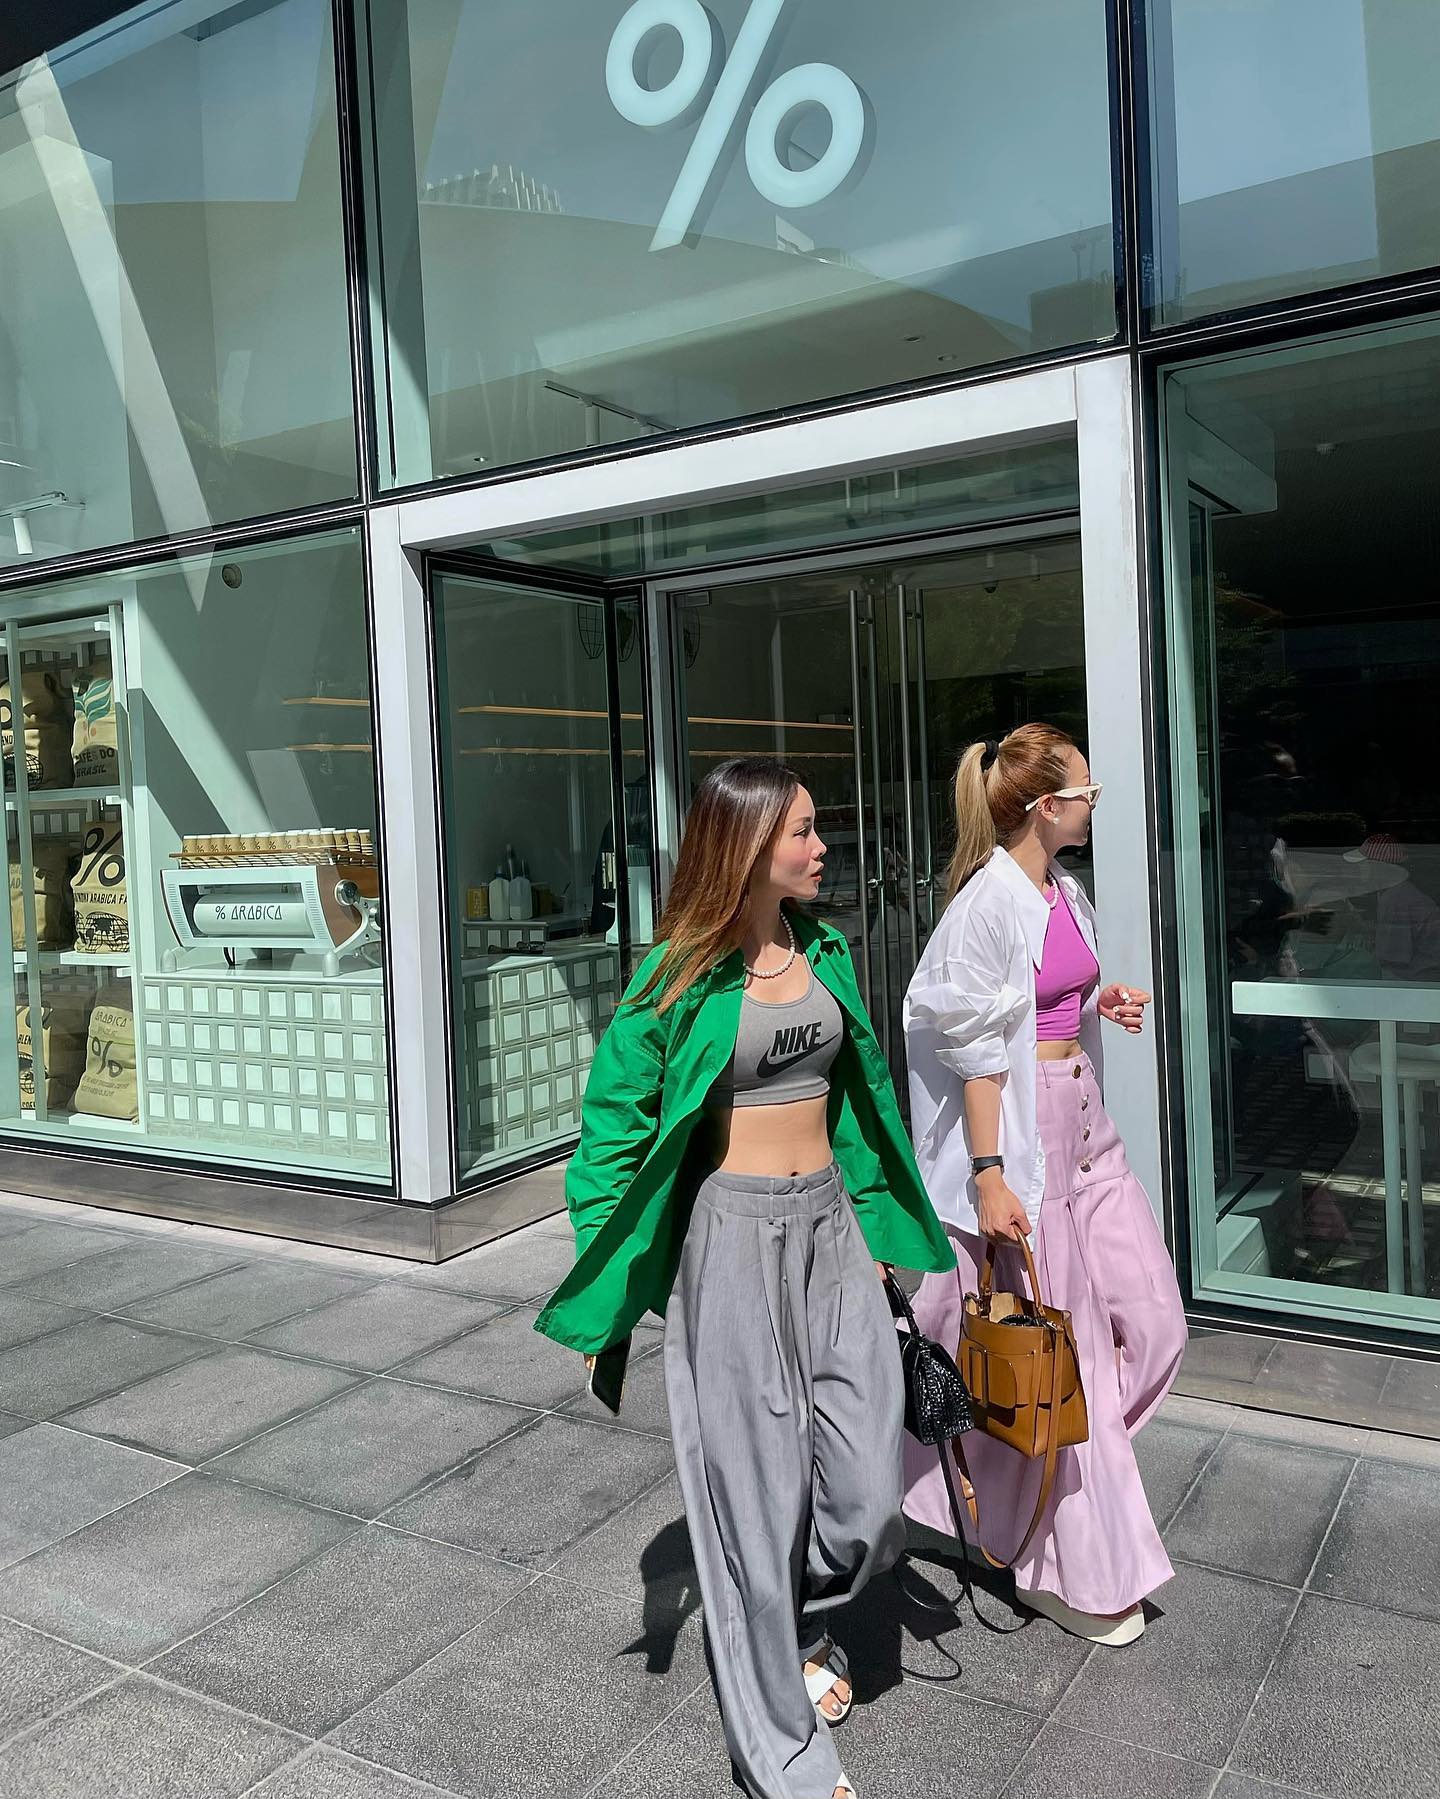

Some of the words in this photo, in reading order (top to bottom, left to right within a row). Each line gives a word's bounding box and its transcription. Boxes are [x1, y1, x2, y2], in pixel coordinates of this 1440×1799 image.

[605, 0, 866, 252] %
[99, 748, 115, 759] DO
[90, 893, 116, 904] ARABICA
[215, 905, 225, 920] %
[231, 905, 282, 920] ARABICA
[95, 1011, 127, 1028] ARABICA
[770, 1021, 822, 1057] NIKE
